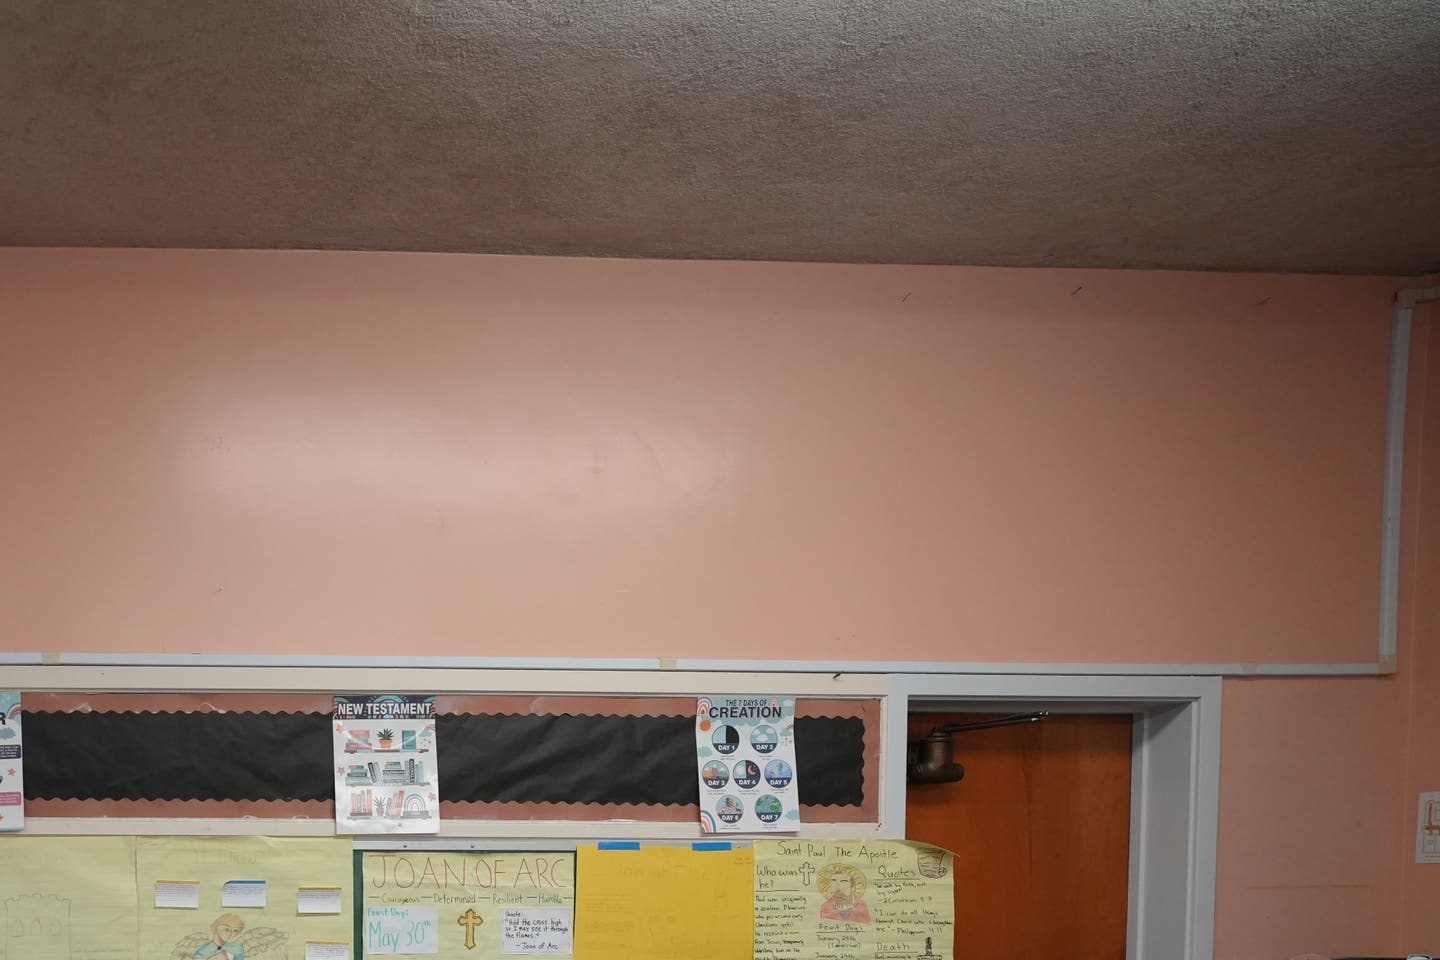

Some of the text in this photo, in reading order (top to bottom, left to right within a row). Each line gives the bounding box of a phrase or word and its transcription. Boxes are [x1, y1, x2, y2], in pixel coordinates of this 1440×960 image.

[338, 702, 432, 715] NEW TESTAMENT
[743, 699, 758, 707] DAYS
[709, 706, 781, 718] CREATION
[776, 840, 899, 864] Saint Paul The Apostle
[368, 854, 567, 889] JOAN OF ARC
[756, 865, 799, 877] Who was
[878, 864, 916, 878] Quotes
[759, 879, 774, 889] he?
[433, 892, 476, 904] Determined
[492, 892, 522, 904] Resilient
[368, 908, 388, 917] Feast
[368, 921, 400, 952] May
[877, 943, 910, 951] Death
